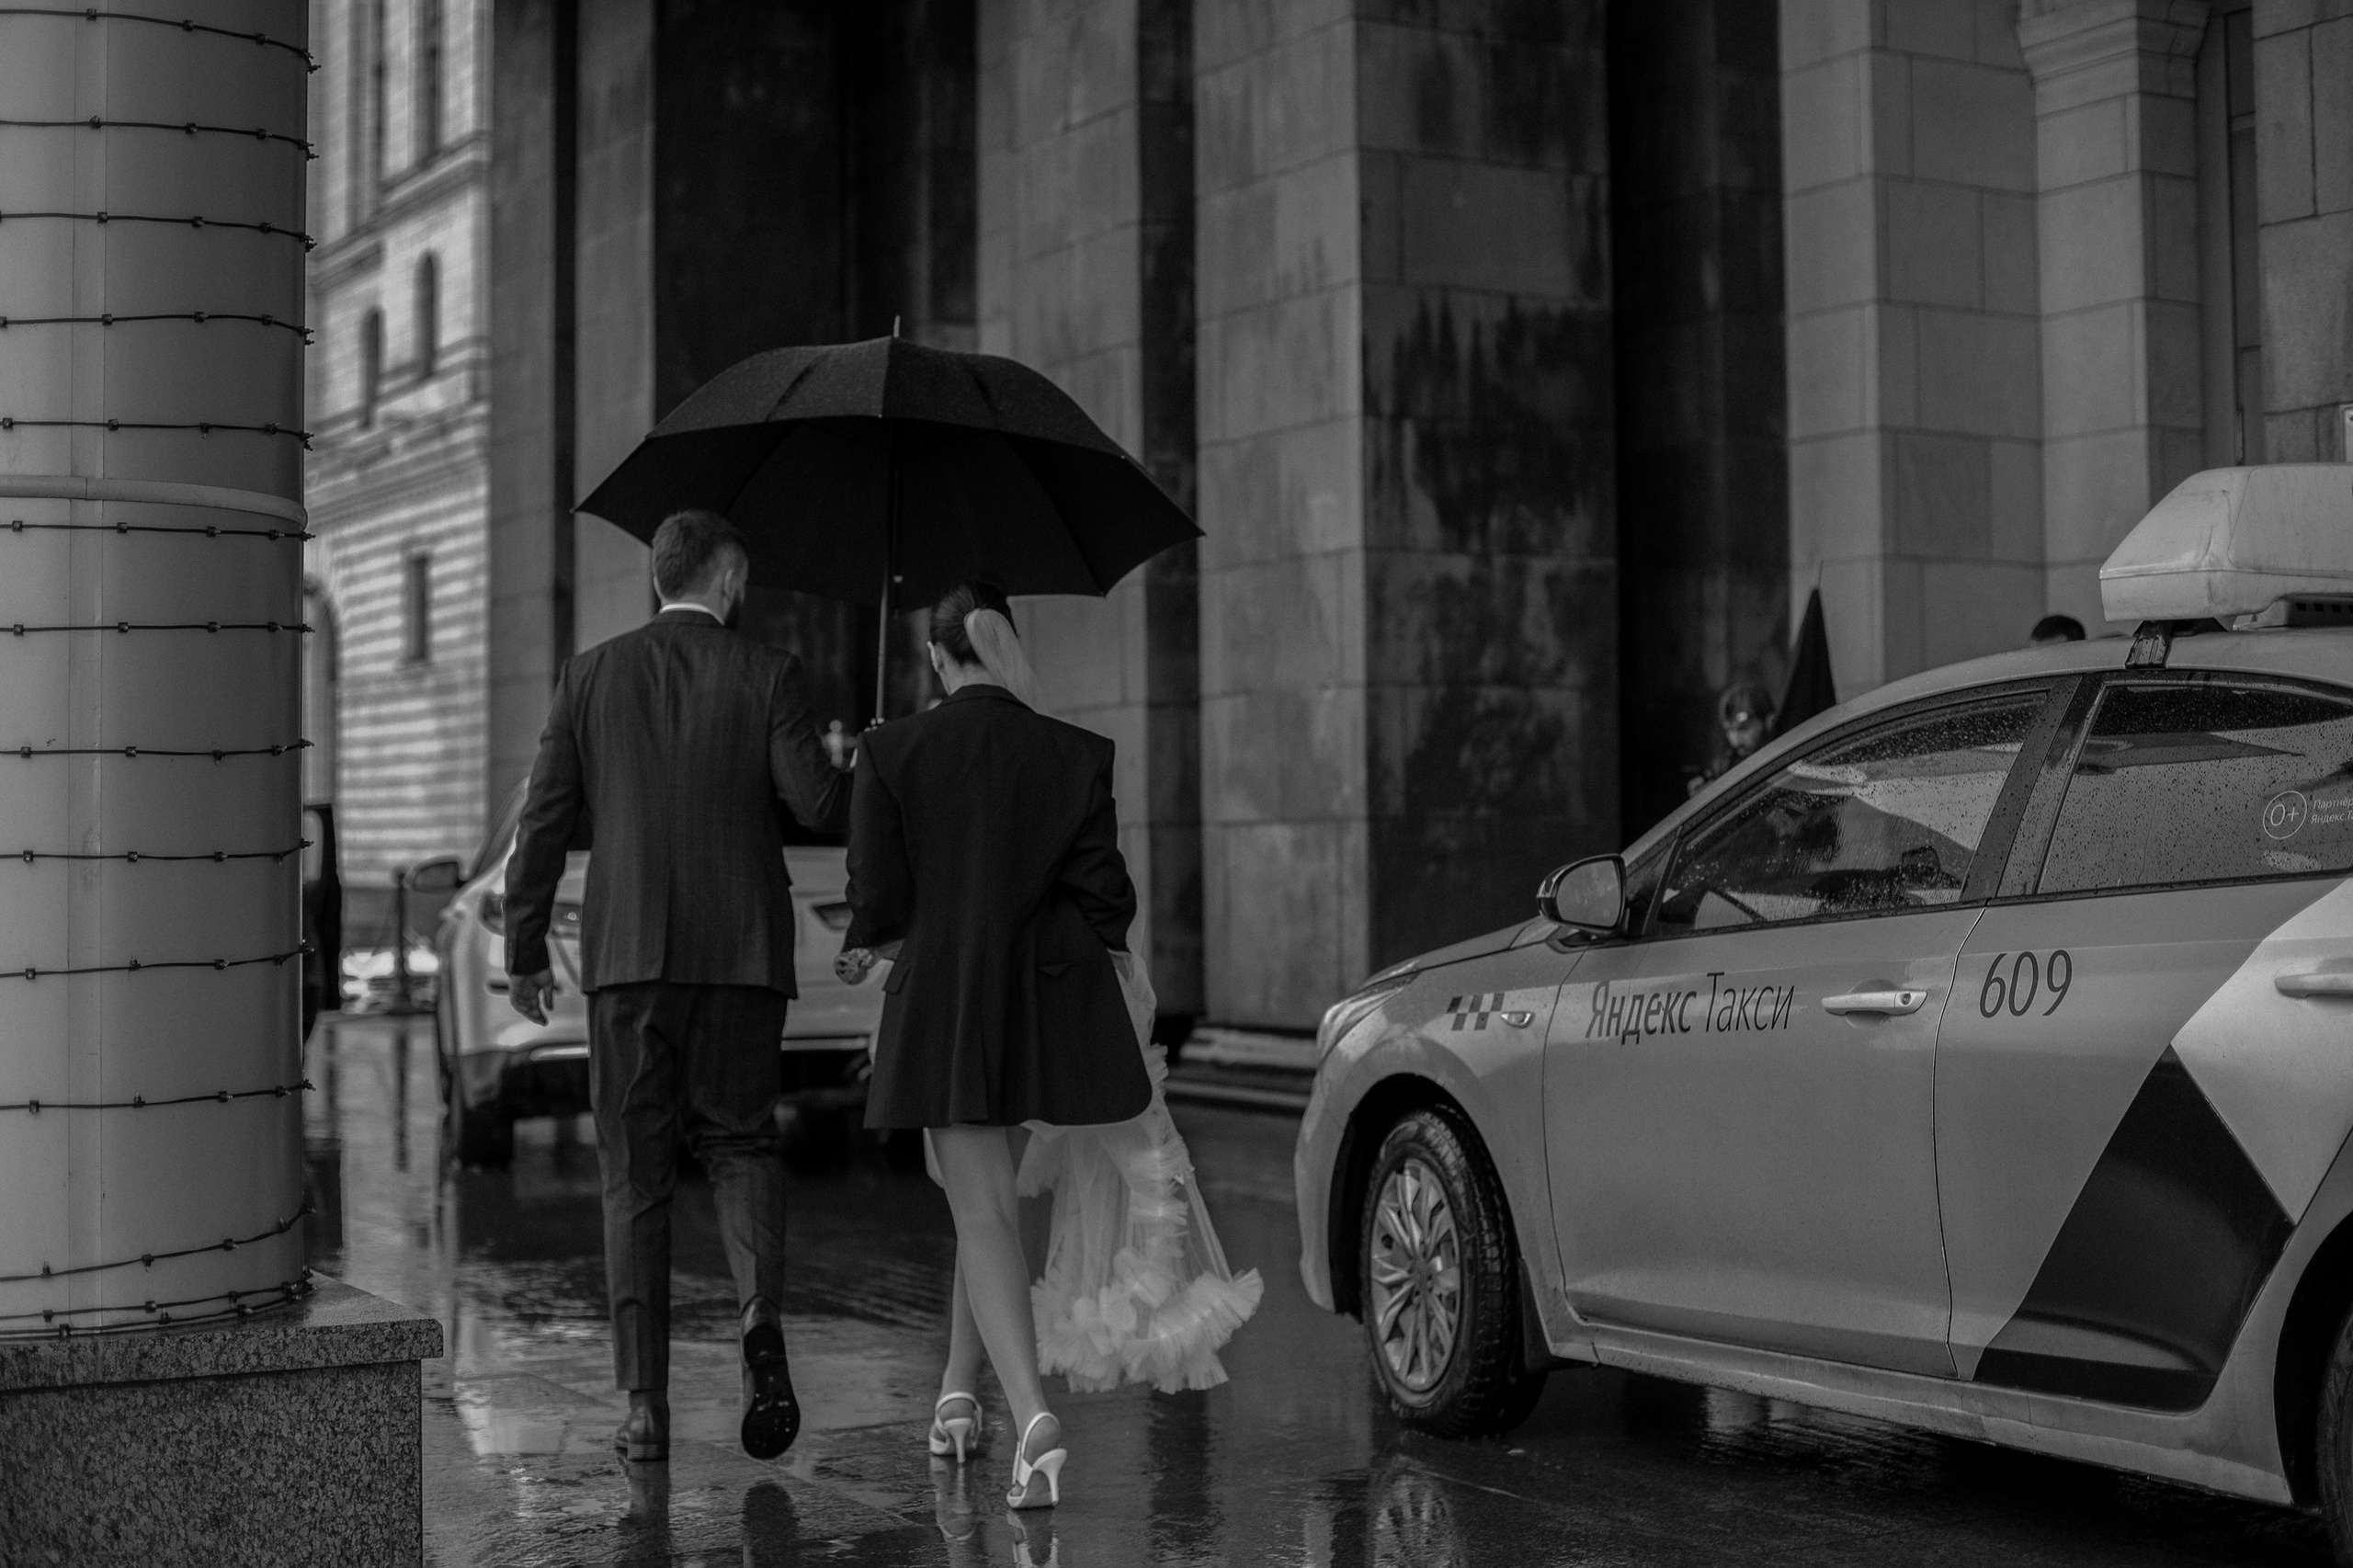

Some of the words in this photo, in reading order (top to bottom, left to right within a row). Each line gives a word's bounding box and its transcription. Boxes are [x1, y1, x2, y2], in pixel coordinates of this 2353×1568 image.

[1586, 980, 1697, 1045] Яндекс
[1705, 971, 1795, 1032] Такси
[1979, 949, 2073, 1018] 609
